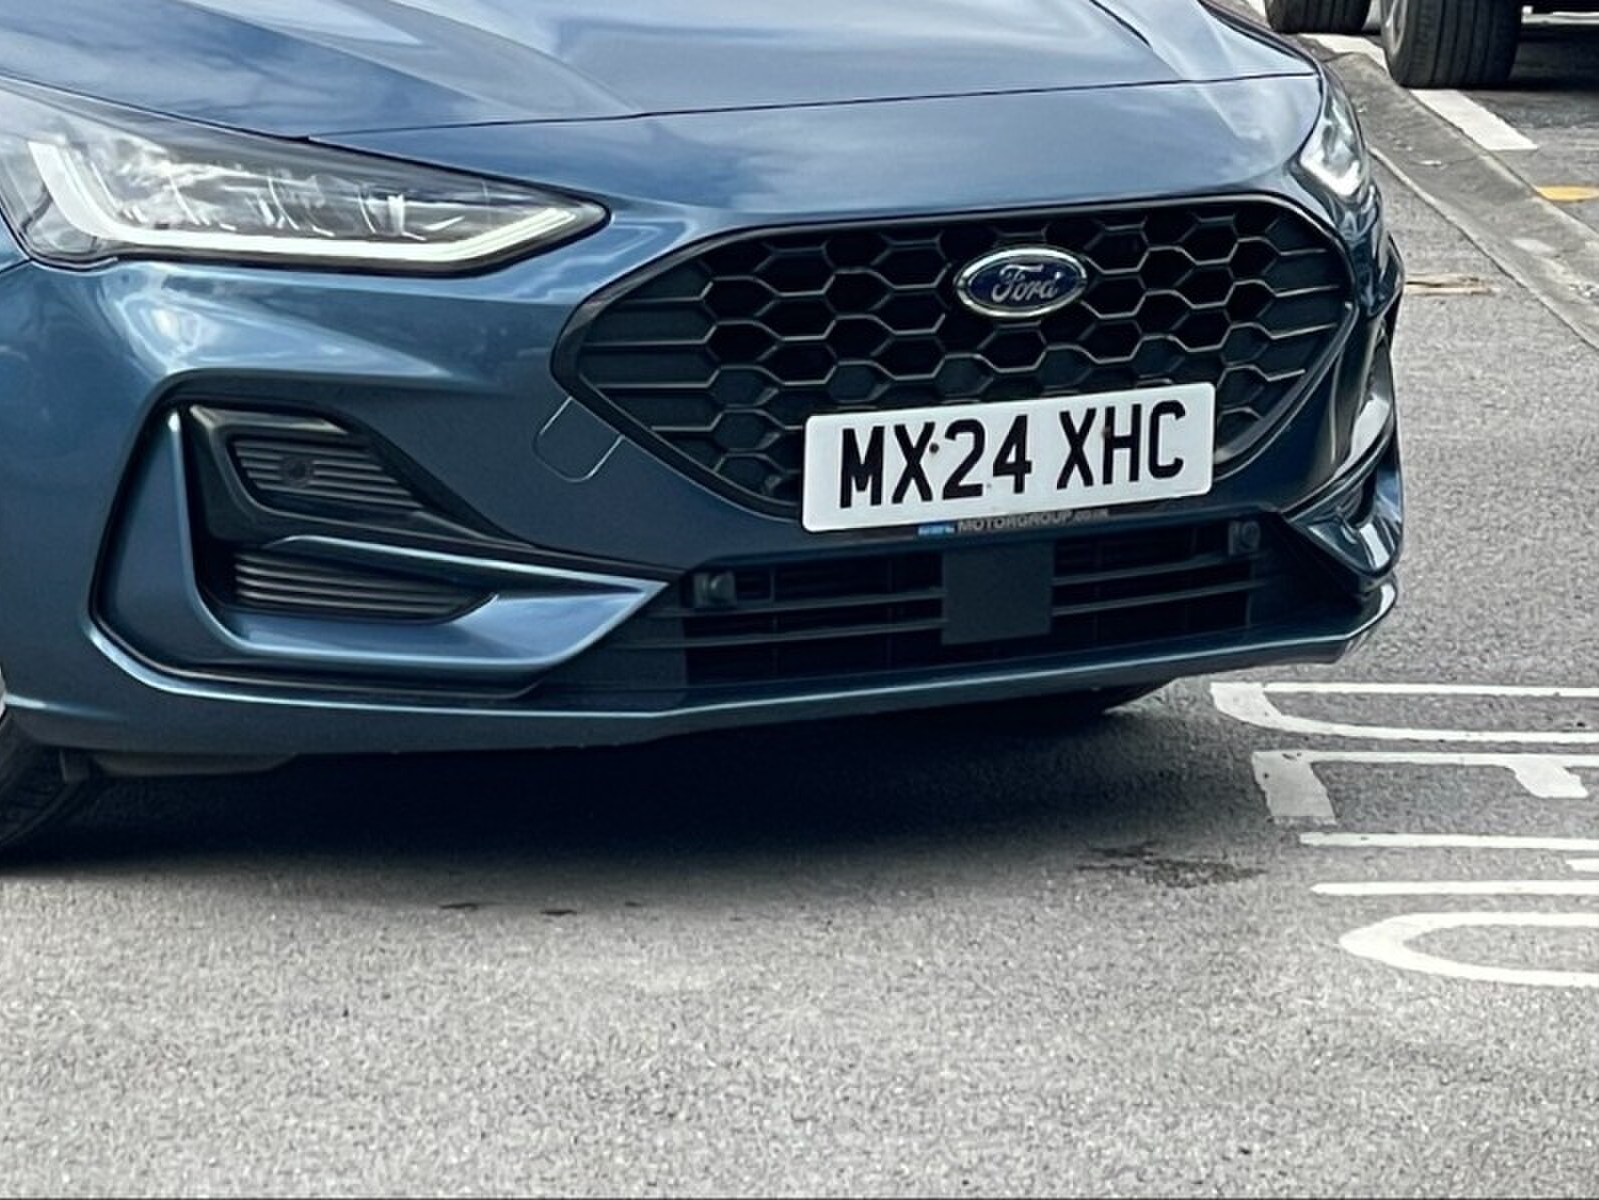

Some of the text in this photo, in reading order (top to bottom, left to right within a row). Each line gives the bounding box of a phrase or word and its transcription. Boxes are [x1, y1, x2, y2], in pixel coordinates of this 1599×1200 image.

[991, 263, 1061, 301] Ford
[839, 399, 1187, 510] MX24 XHC
